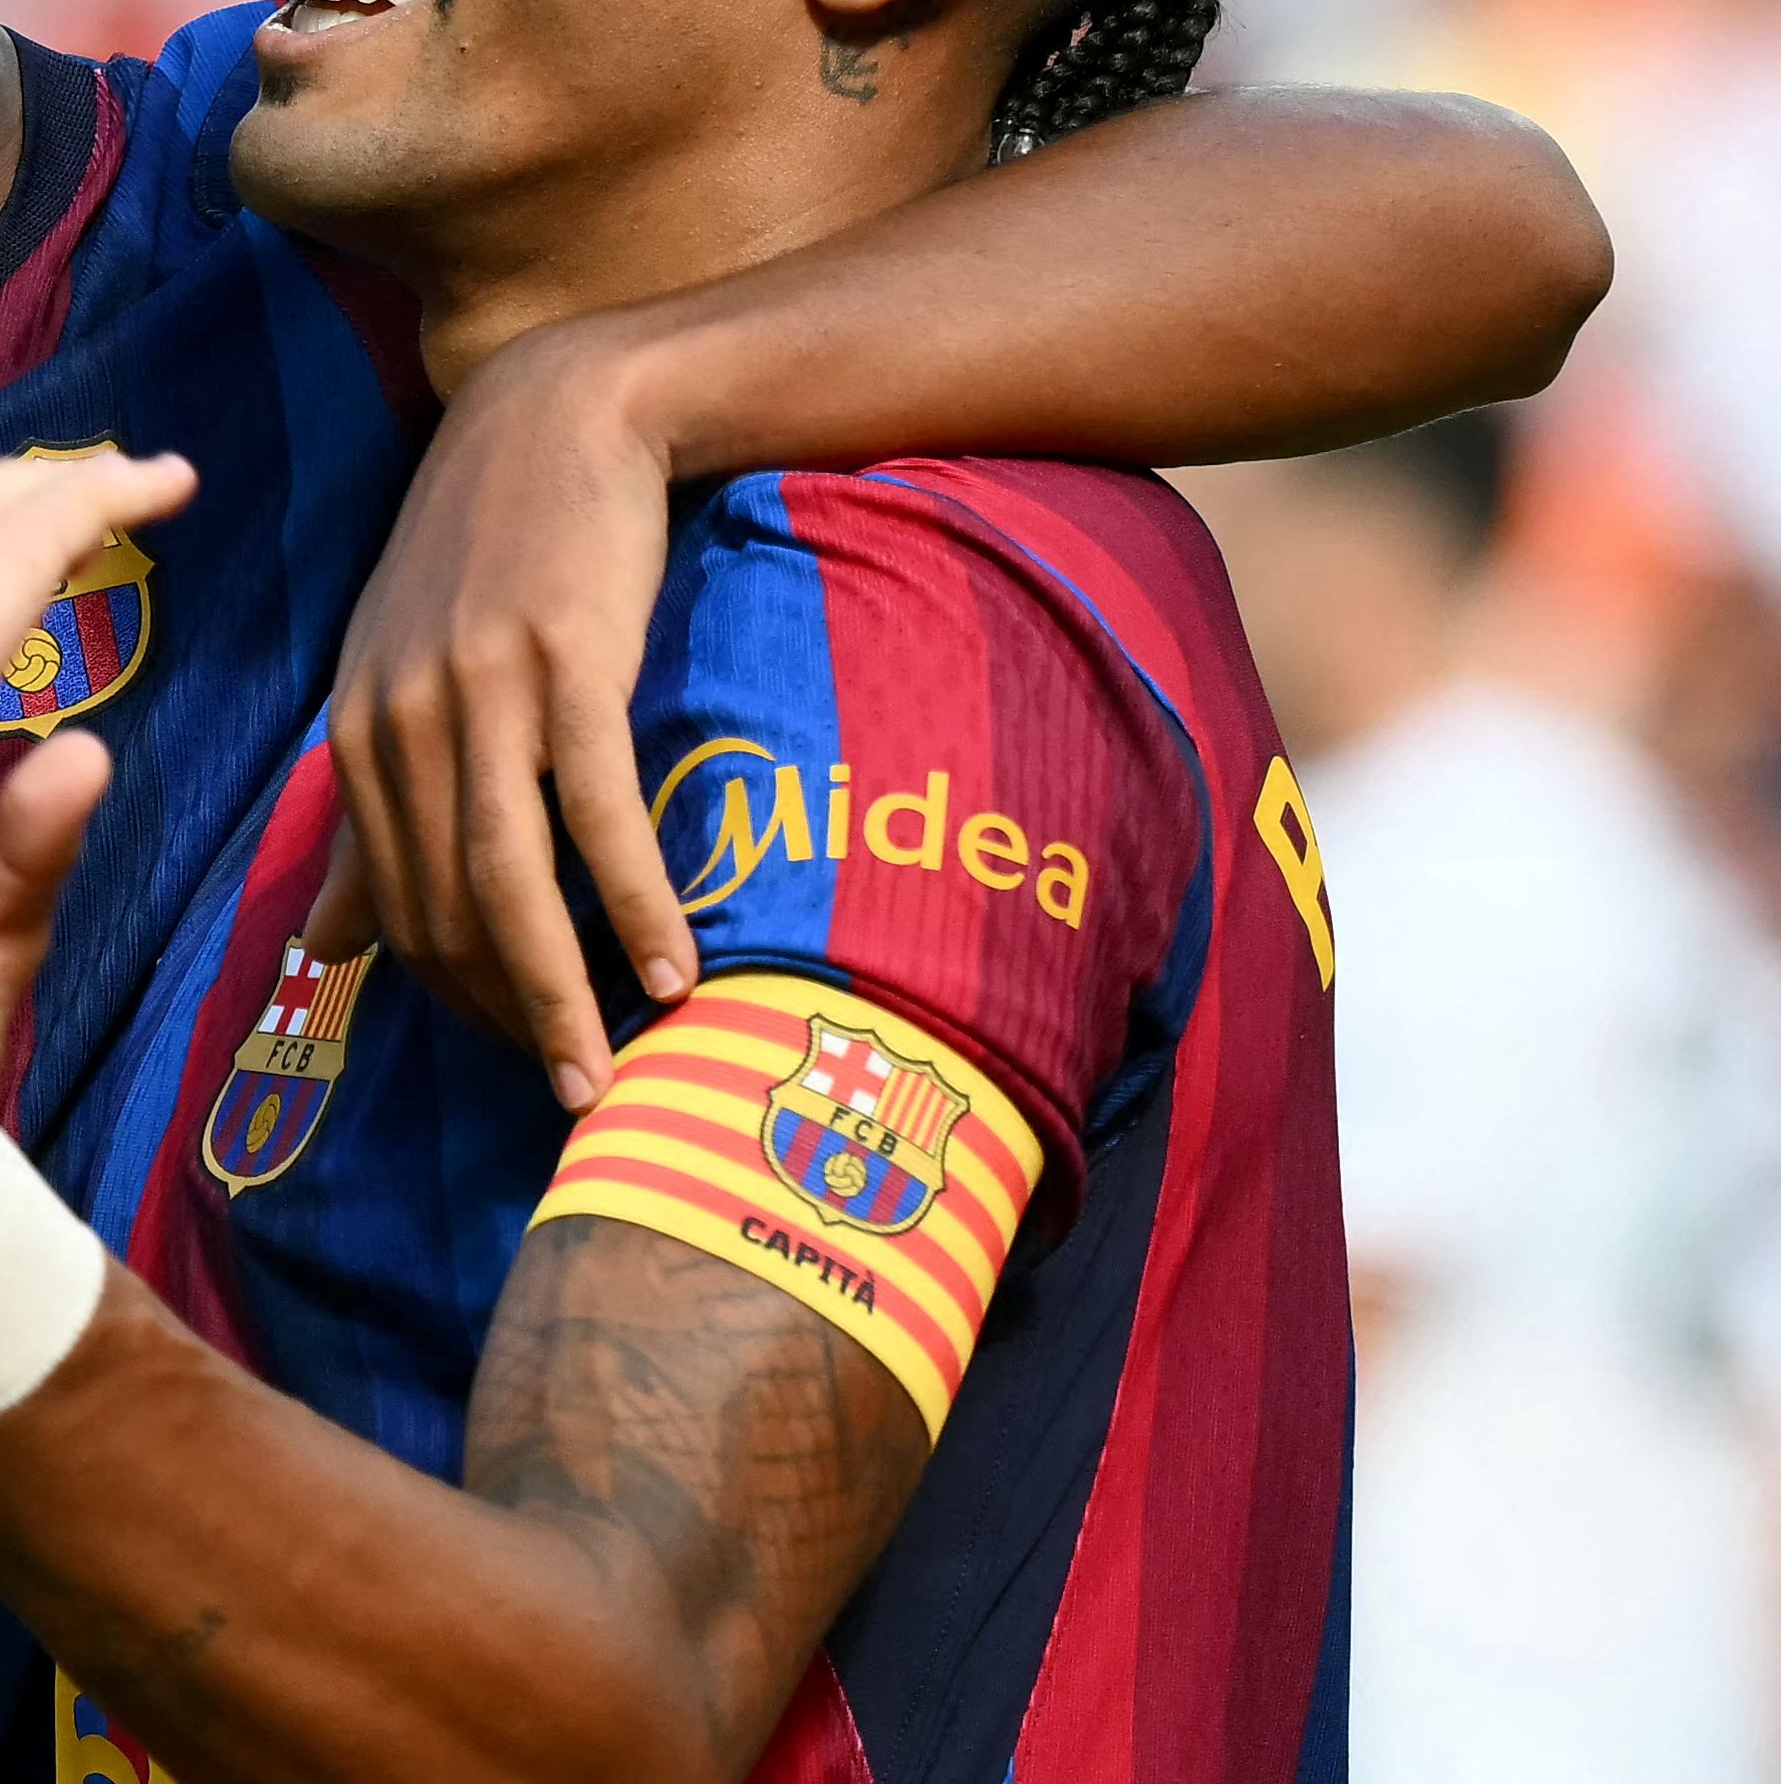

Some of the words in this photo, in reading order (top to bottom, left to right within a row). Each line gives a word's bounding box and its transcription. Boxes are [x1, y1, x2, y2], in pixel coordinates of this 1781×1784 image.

[651, 737, 1091, 931] Midea
[265, 1040, 315, 1073] FCB
[828, 1106, 898, 1156] FCB
[740, 1216, 877, 1315] CAPITÀ
